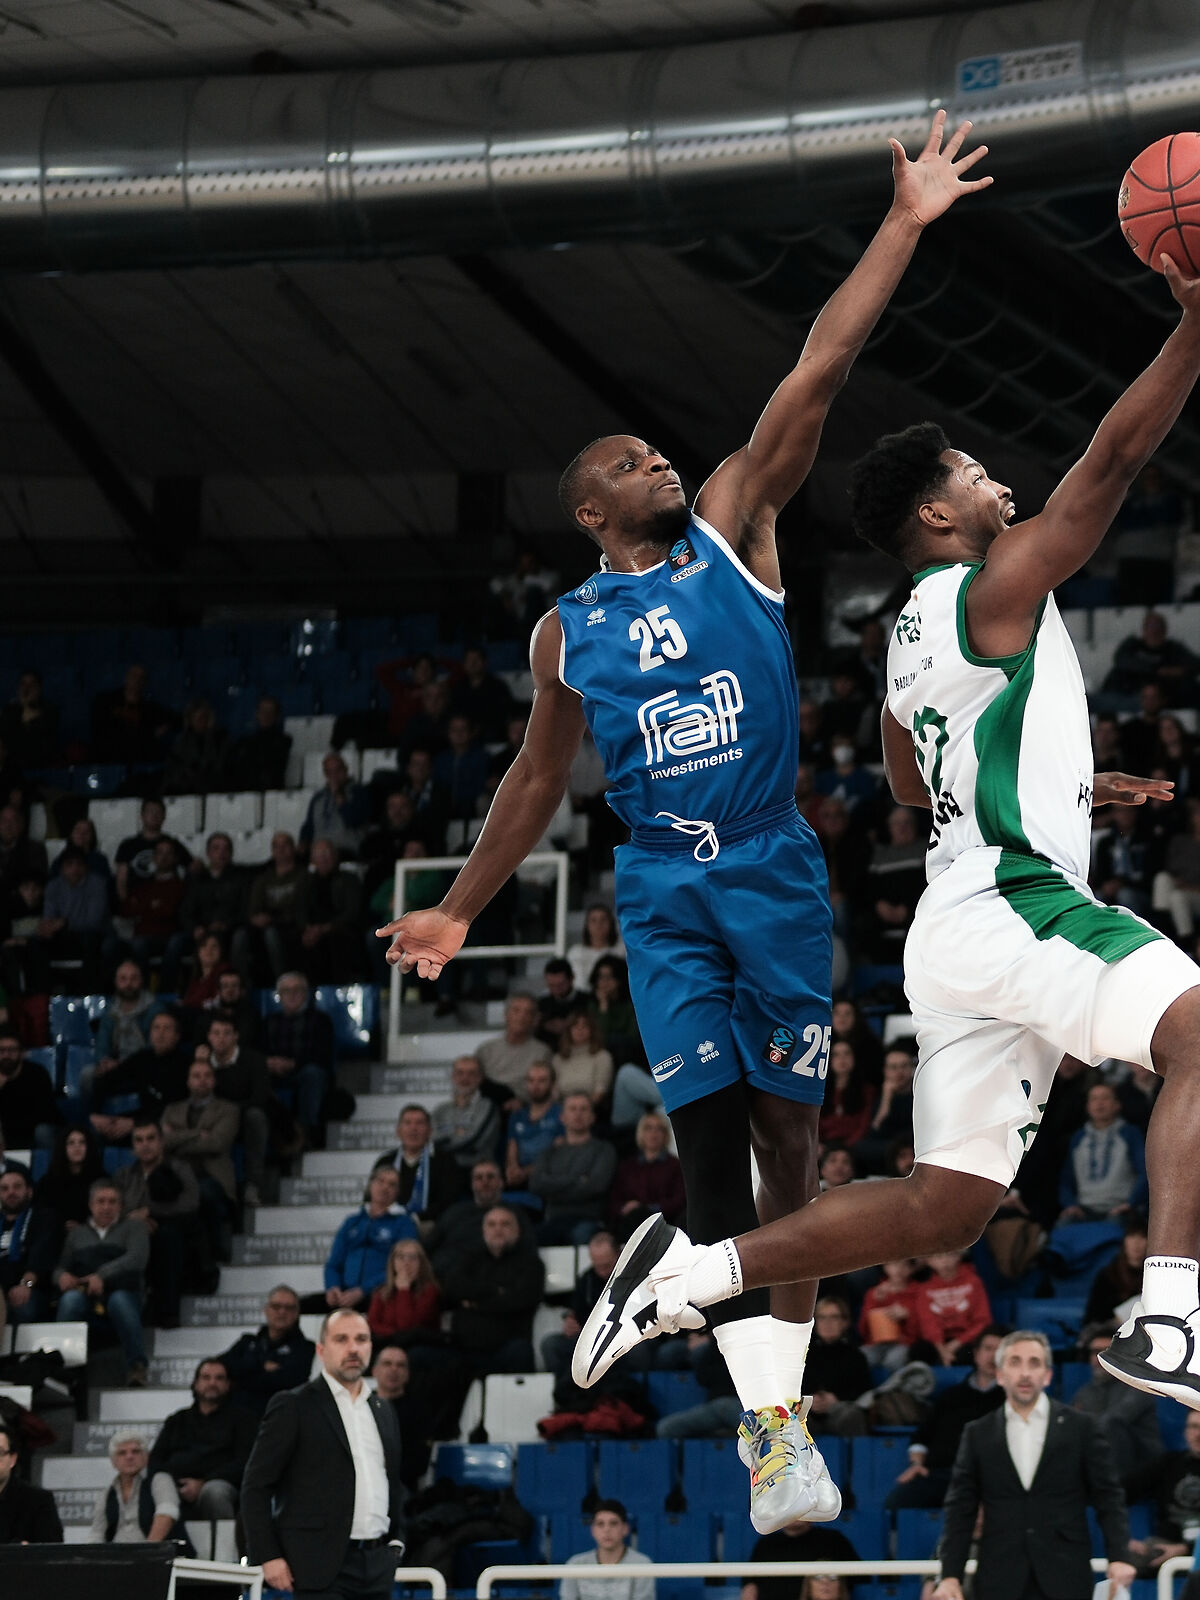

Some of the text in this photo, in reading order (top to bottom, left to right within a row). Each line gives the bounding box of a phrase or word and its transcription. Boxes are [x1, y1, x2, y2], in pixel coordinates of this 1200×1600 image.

[628, 604, 688, 673] 25
[648, 747, 744, 780] investments
[791, 1023, 832, 1080] 25
